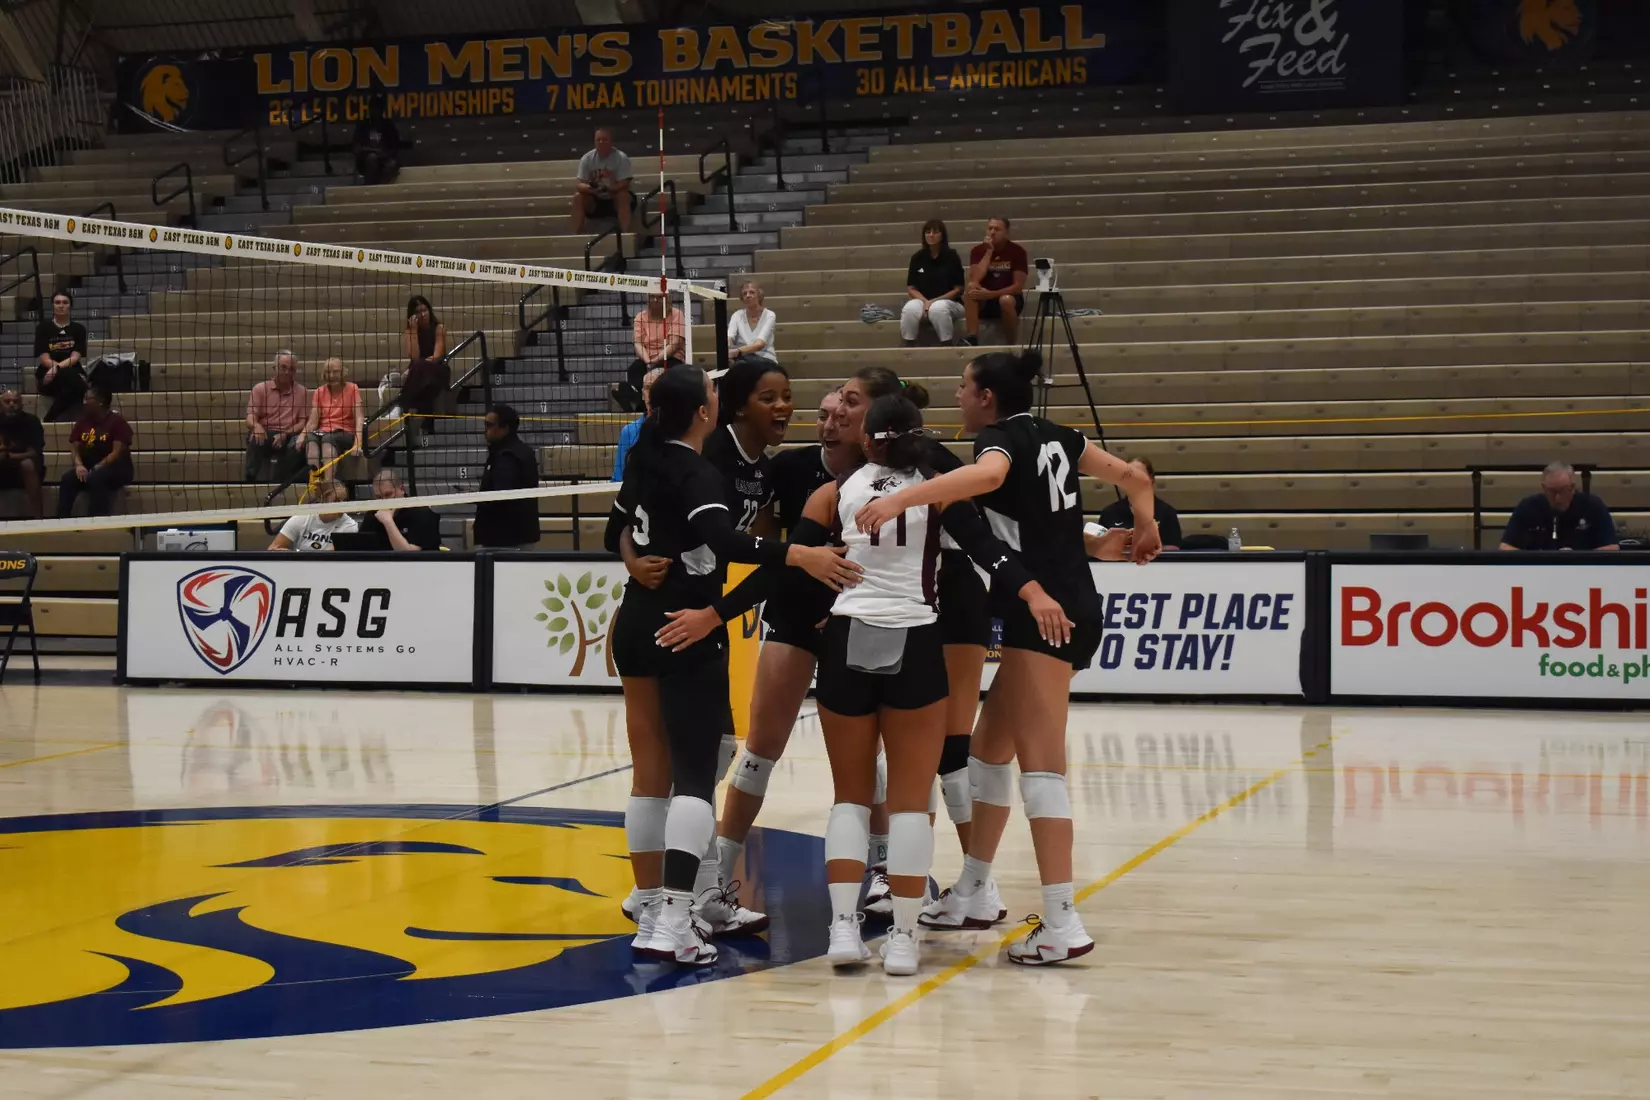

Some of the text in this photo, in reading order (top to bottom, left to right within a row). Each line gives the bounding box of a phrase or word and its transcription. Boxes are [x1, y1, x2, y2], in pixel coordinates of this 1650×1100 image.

[1218, 0, 1338, 46] Fix &
[253, 4, 1106, 95] LION MEN'S BASKETBALL
[1239, 33, 1349, 88] Feed
[345, 86, 515, 123] CHMPIONSHIPS
[546, 84, 560, 112] 7
[567, 81, 626, 111] NCAA
[633, 72, 798, 107] TOURNAMENTS
[856, 67, 885, 95] 30
[893, 56, 1088, 92] ALL-AMERICANS
[16, 215, 42, 228] TEXAS
[82, 223, 101, 235] EAST
[103, 225, 126, 238] TEXAS
[163, 231, 182, 242] EAST
[183, 233, 204, 245] TEXAS
[238, 239, 254, 250] EAST
[255, 241, 275, 252] TEXAS
[306, 246, 321, 257] EAST
[322, 248, 341, 259] TEXAS
[369, 252, 382, 261] EAST
[384, 254, 400, 264] TEXAS
[1036, 440, 1077, 513] 12
[734, 499, 757, 534] 22
[275, 587, 391, 639] ASG
[1098, 592, 1294, 630] EST PLACE
[1341, 586, 1648, 649] Brookshi
[274, 657, 338, 666] HVAC-R
[275, 643, 303, 652] ALL
[315, 644, 385, 653] SYSTEMS
[1085, 633, 1235, 671] O STAY!
